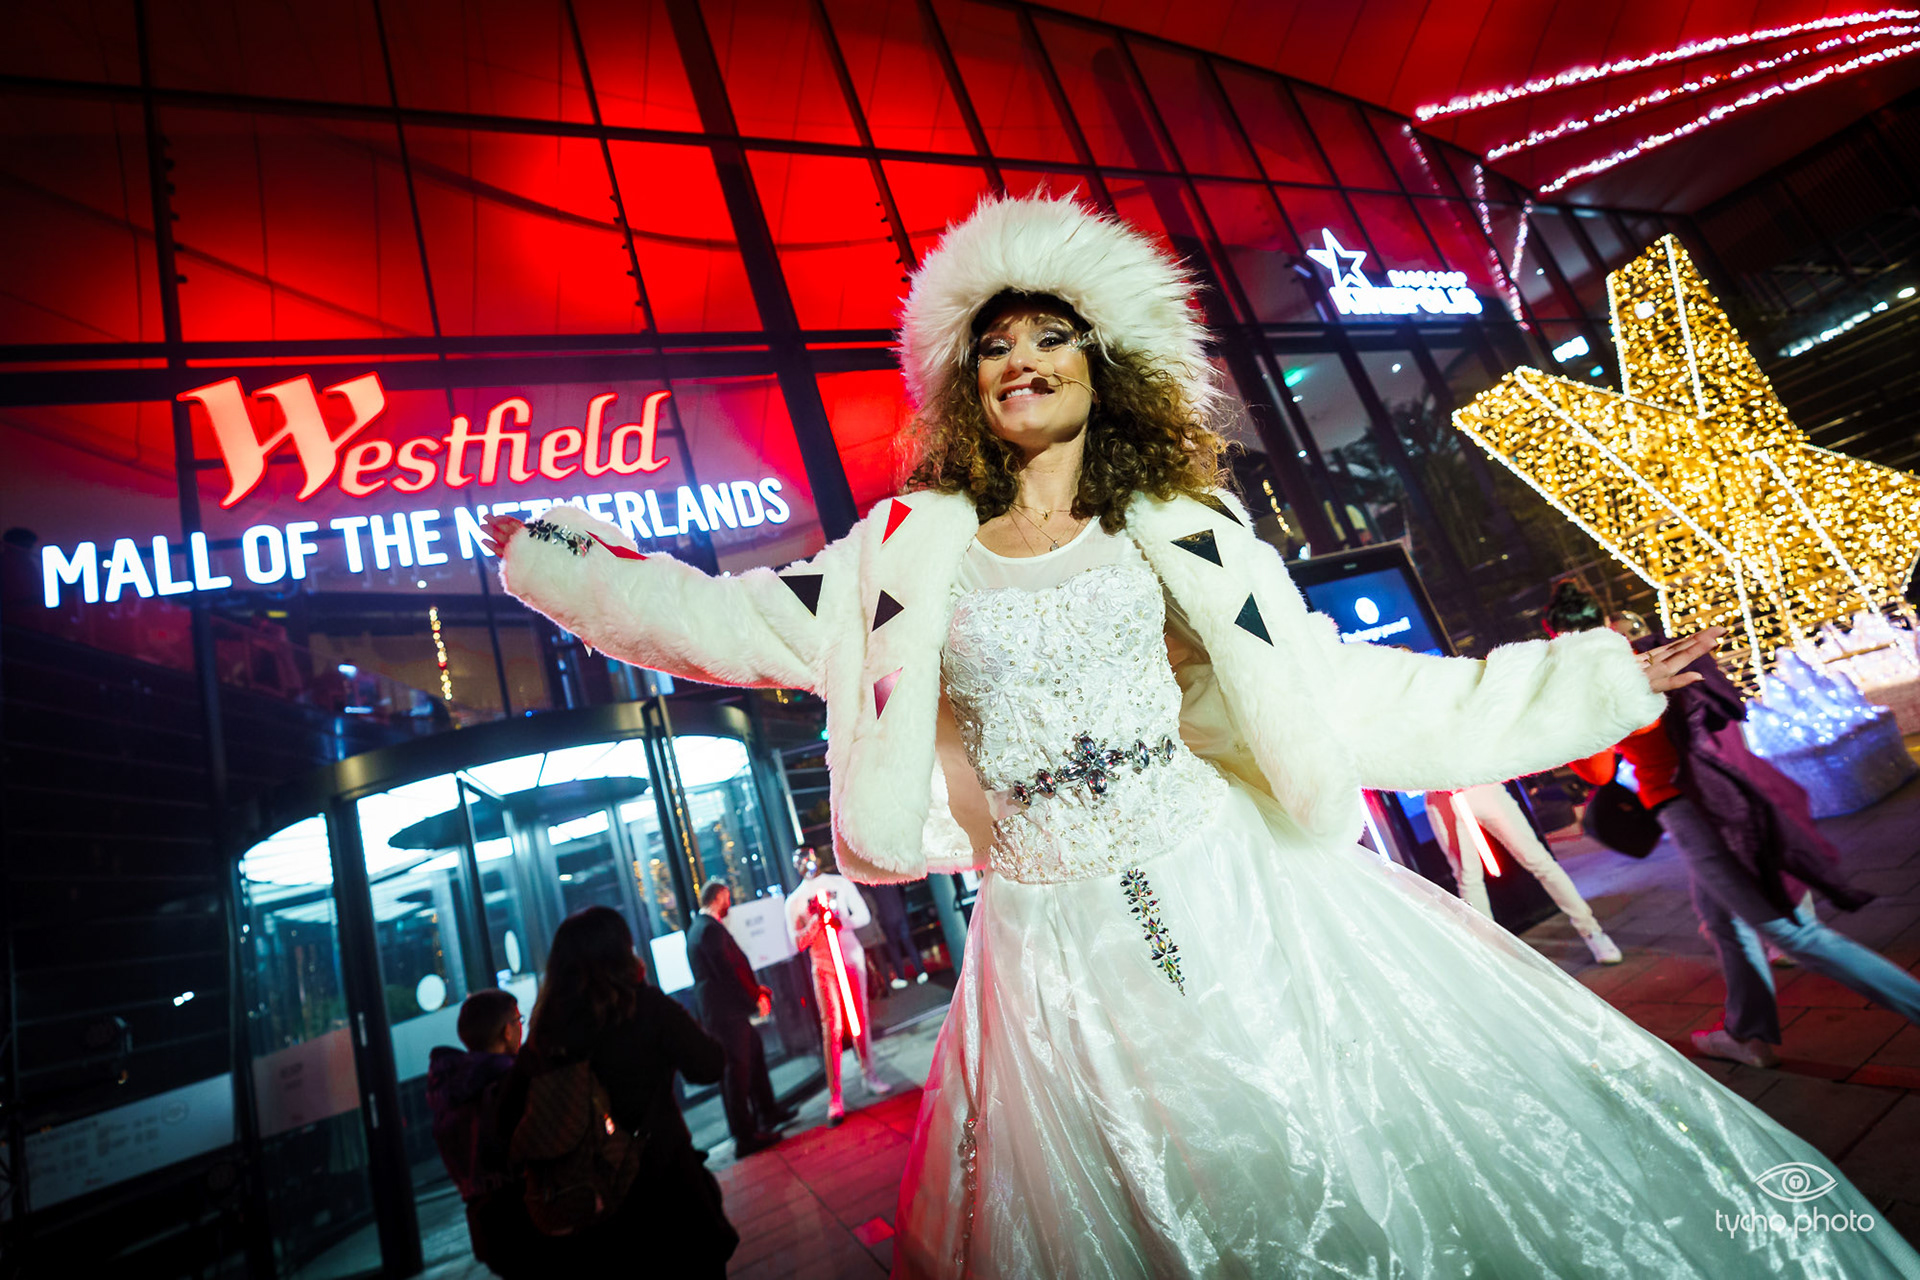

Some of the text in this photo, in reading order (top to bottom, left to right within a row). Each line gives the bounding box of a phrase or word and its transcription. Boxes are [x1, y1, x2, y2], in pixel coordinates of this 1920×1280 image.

[179, 373, 671, 508] Westfield
[41, 476, 791, 608] MALL OF THE NTERLANDS
